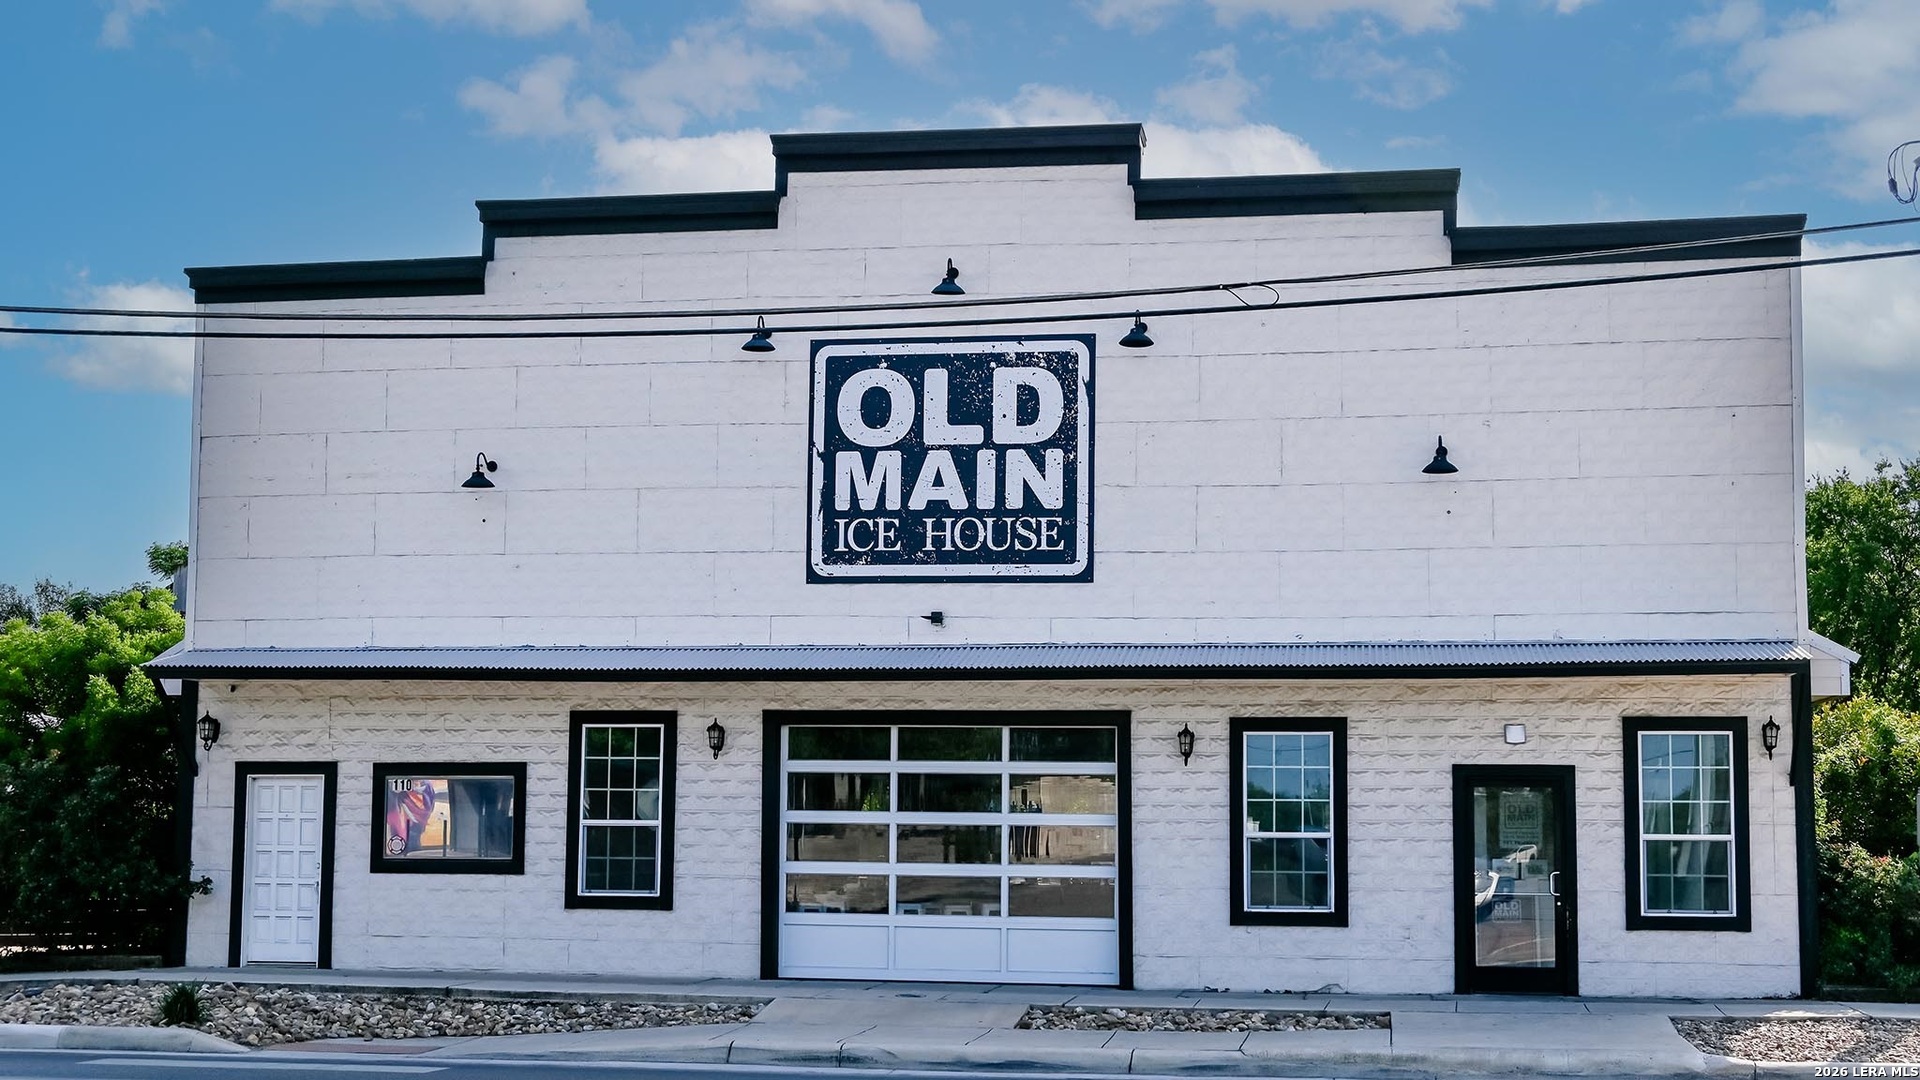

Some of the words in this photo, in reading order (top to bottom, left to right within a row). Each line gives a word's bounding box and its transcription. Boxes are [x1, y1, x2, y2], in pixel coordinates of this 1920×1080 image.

[837, 366, 1064, 447] OLD
[834, 448, 1064, 511] MAIN
[834, 518, 901, 552] ICE
[922, 516, 1065, 551] HOUSE
[394, 779, 412, 791] 110
[1507, 804, 1535, 814] OLD
[1507, 814, 1537, 822] MAIN
[1494, 901, 1519, 910] OLD
